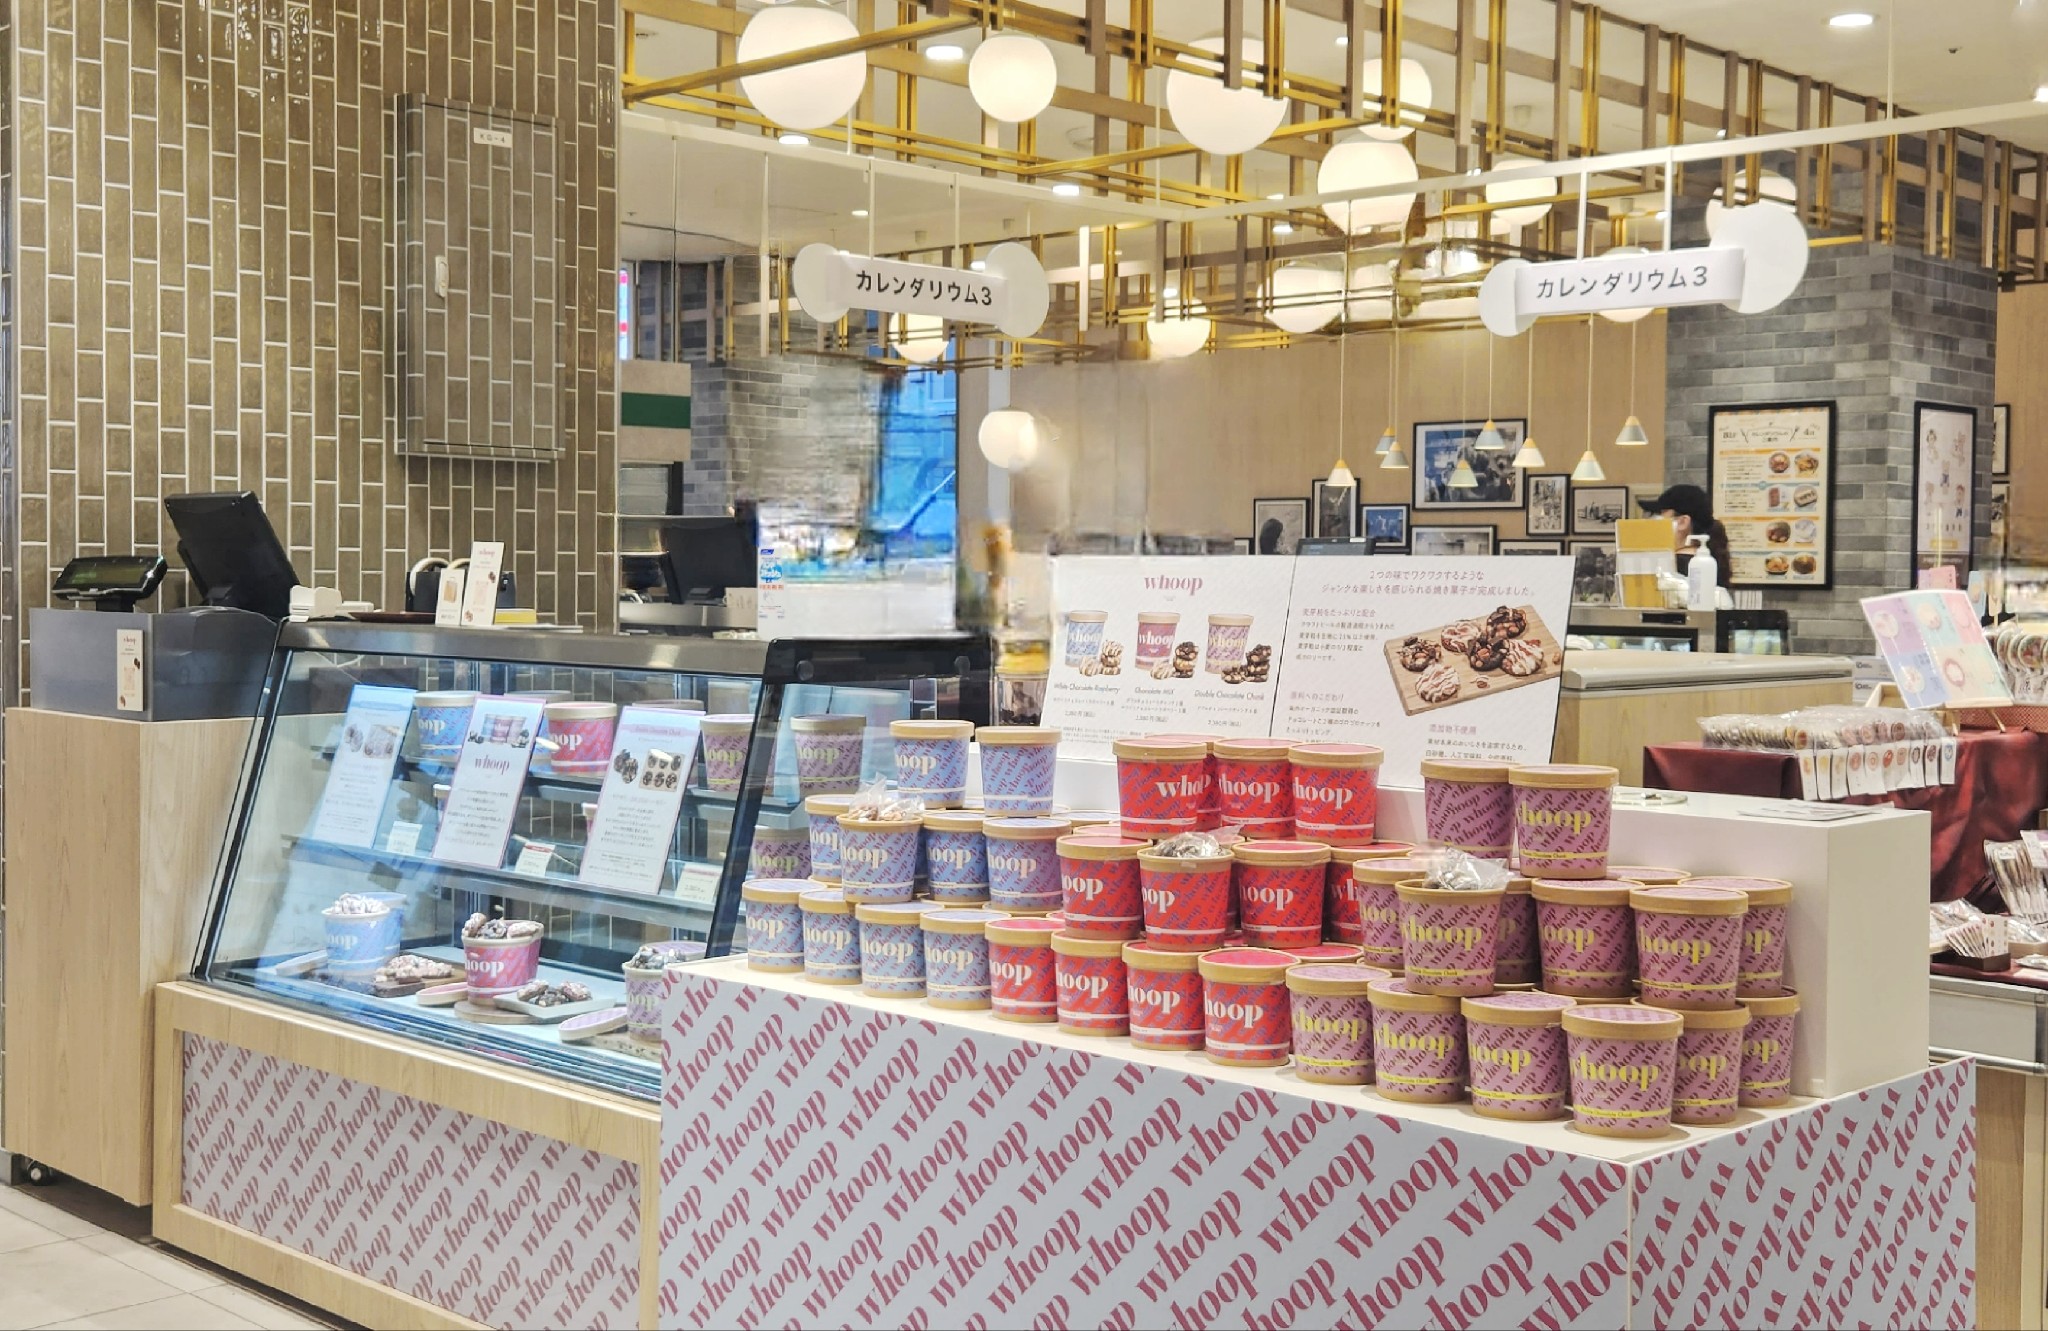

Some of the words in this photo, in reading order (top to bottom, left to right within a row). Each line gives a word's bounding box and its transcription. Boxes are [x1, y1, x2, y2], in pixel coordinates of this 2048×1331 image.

[856, 270, 993, 306] カレンダリウム3
[1536, 265, 1708, 299] カレンダリウム3
[1144, 574, 1204, 596] whoop
[1321, 584, 1536, 597] ジャンクな楽しさを感じられる焼き菓子が完成しました。
[1369, 570, 1485, 581] 2つの味でワクワクするような
[1194, 690, 1216, 698] Double
[1216, 690, 1246, 699] Chocolate
[474, 755, 511, 776] whoop
[841, 844, 890, 870] hoop
[927, 844, 973, 870] hoop
[987, 853, 1038, 879] hoop
[804, 920, 853, 950] hoop
[861, 930, 915, 964] hoop
[925, 943, 975, 973] hoop
[1638, 925, 1712, 967] hoop
[1055, 969, 1109, 999] hoop
[1128, 978, 1181, 1015] hoop
[1204, 990, 1265, 1029] hoop
[665, 1015, 733, 1107] whoop
[712, 1014, 783, 1108] whoop
[777, 1003, 851, 1086] whoop
[828, 1013, 905, 1087] whoo
[969, 1042, 1042, 1117] whoo
[187, 1081, 230, 1153] whoop
[331, 1084, 381, 1160] whoop
[839, 1039, 919, 1138] whoop
[893, 1038, 977, 1141] whoop
[192, 1117, 236, 1189] whoop
[220, 1117, 265, 1191] whoop
[259, 1100, 305, 1168] whoop
[288, 1100, 338, 1178] whoop
[704, 1091, 775, 1182] whoop
[752, 1092, 826, 1184] whoop
[884, 1120, 968, 1220] whoop
[940, 1122, 1028, 1225] whoop
[1019, 1096, 1113, 1204] whoop
[1082, 1098, 1182, 1207] whoop
[1172, 1089, 1278, 1185] whoop
[1243, 1101, 1337, 1189] whoo
[1834, 1089, 1899, 1238] whoop
[283, 1160, 332, 1235] whoop
[314, 1161, 364, 1238] whoop
[358, 1142, 410, 1221] whoop
[391, 1149, 446, 1225] whoop
[482, 1170, 541, 1253] whoop
[520, 1170, 581, 1257] whoop
[764, 1142, 838, 1236] whoop
[814, 1144, 891, 1240] whoop
[1259, 1134, 1375, 1253] whoop
[1337, 1137, 1459, 1258] whoop
[1445, 1145, 1554, 1236] whoo
[1787, 1117, 1856, 1272] whoop
[399, 1184, 452, 1266] whoop
[433, 1187, 490, 1269] whoop
[680, 1188, 749, 1277] whoop
[931, 1205, 1018, 1306] whoop
[989, 1209, 1081, 1312] whoop
[1071, 1187, 1169, 1295] whoop
[1137, 1190, 1241, 1301] whoop
[1653, 1163, 1733, 1331] whoop
[1826, 1185, 1893, 1331] whoop
[1872, 1154, 1935, 1303] whoop
[513, 1238, 576, 1323] whoop
[554, 1241, 617, 1327] whoop
[690, 1237, 760, 1327] whoop
[738, 1242, 811, 1331] whoop
[804, 1223, 882, 1316] whoop
[857, 1226, 939, 1323] whoop
